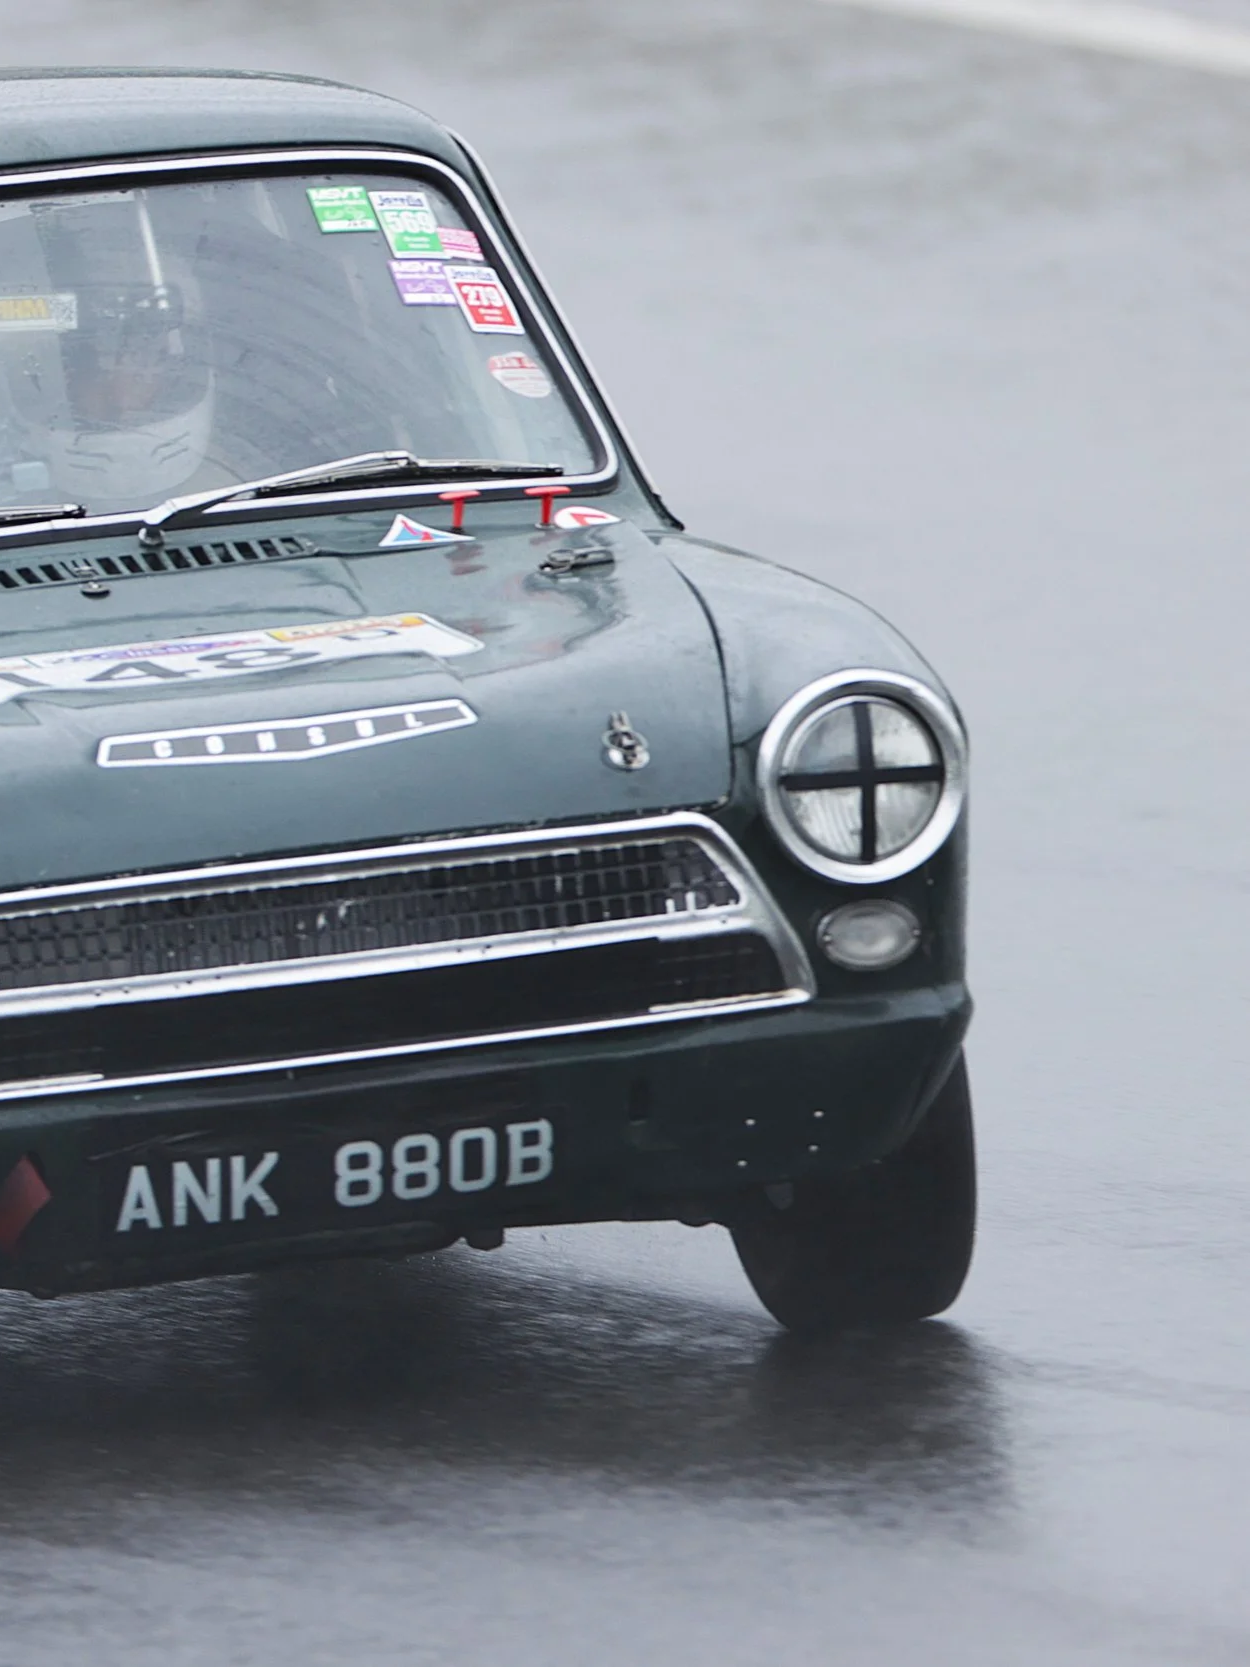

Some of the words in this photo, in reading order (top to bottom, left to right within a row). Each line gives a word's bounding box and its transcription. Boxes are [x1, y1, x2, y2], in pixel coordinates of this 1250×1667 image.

[153, 712, 424, 759] CONSUL
[116, 1152, 279, 1231] ANK
[335, 1118, 553, 1207] 880B
